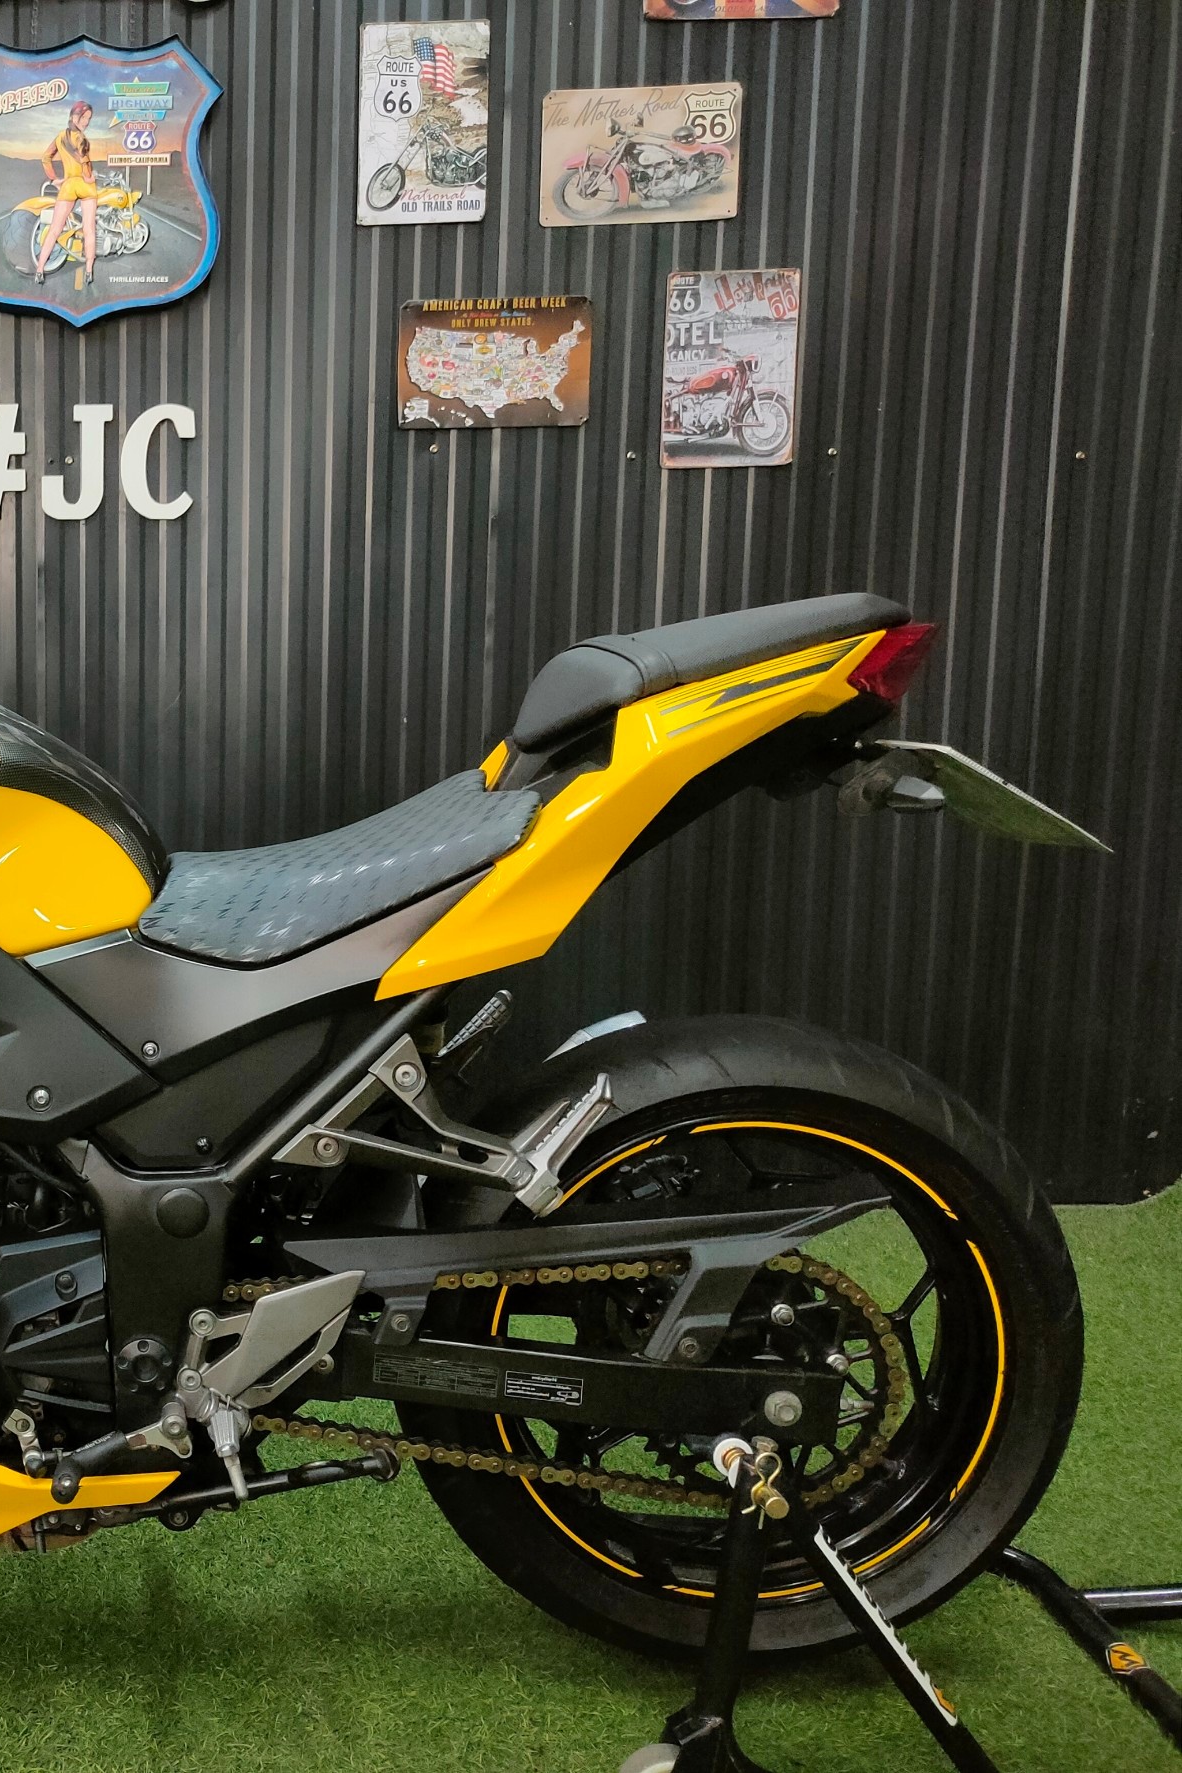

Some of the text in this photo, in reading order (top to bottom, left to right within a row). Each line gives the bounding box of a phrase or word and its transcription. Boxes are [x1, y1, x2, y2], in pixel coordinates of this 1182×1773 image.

[385, 61, 414, 73] ROUTE
[390, 79, 407, 88] US
[112, 99, 169, 108] HIGHWAY
[383, 90, 412, 114] 66
[695, 99, 725, 109] ROUTE
[544, 89, 686, 132] The Mother Road
[691, 113, 728, 140] 66
[126, 131, 152, 149] 66
[109, 156, 168, 164] ILLINOIS-CALIFORNIA
[401, 185, 466, 202] National
[401, 199, 480, 213] OLD TRAILS ROAD
[673, 276, 695, 285] OUTE
[423, 296, 567, 312] AMERICAN CRAFT BEER WEEK
[670, 290, 695, 312] 66
[770, 289, 797, 319] 66
[451, 318, 472, 328] ONLY
[474, 318, 497, 328] BREW
